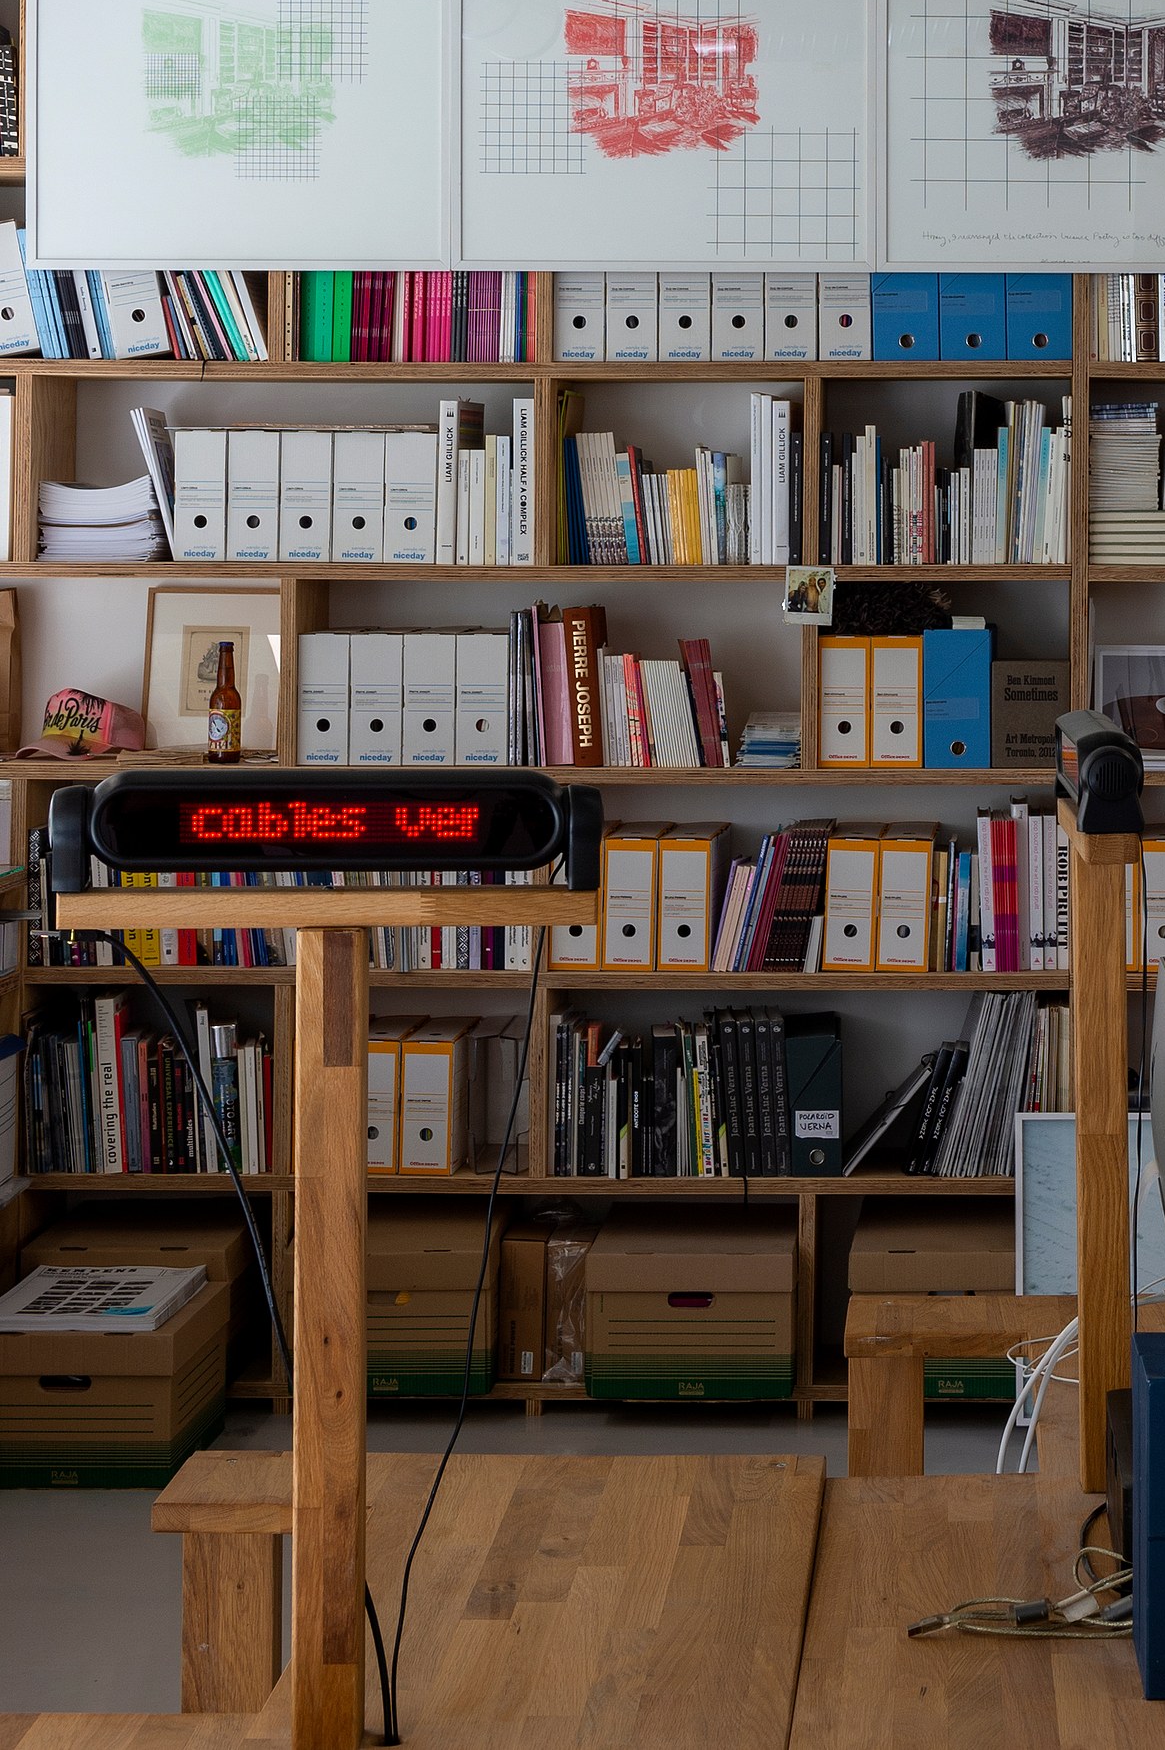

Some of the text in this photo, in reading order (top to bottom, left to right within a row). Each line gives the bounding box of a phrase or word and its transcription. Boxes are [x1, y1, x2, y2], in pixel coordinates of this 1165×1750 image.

[127, 341, 160, 354] niceday
[562, 350, 595, 359] niceday
[615, 350, 648, 359] niceday
[668, 350, 701, 359] niceday
[721, 350, 754, 359] niceday
[774, 350, 807, 358] niceday
[829, 349, 862, 358] niceday
[520, 408, 528, 429] LIAM
[520, 430, 528, 463] GILLICK
[445, 461, 453, 483] LIAM
[520, 464, 528, 485] HALF
[778, 463, 786, 483] LIAM
[520, 494, 528, 535] COMPLEX
[183, 550, 216, 559] niceday
[236, 550, 269, 559] niceday
[289, 550, 322, 559] niceday
[341, 550, 374, 559] niceday
[393, 551, 426, 560] niceday
[571, 620, 593, 748] PIERRE JOSEPH
[1007, 675, 1056, 685] Ben Kinmont
[1004, 687, 1059, 702] Sometimes
[60, 697, 103, 732] Paris
[1005, 733, 1019, 744] Art
[306, 753, 339, 762] niceday
[359, 753, 392, 762] niceday
[412, 753, 445, 762] niceday
[465, 753, 498, 762] niceday
[1006, 747, 1037, 759] Toronto,
[191, 801, 479, 839] cables ver
[1057, 845, 1068, 951] ROB PRUITT
[164, 1057, 174, 1148] UNIVERSAL EXPERIENCE
[727, 1065, 740, 1138] Jean-Luc Verna
[744, 1065, 756, 1138] Jean-Luc Verna
[760, 1065, 773, 1138] Jean-Luc Verna
[774, 1065, 787, 1138] Jean-Luc Verna
[100, 1061, 118, 1164] covering the real
[799, 1122, 832, 1131] VERNA
[372, 1377, 398, 1386] RAJA
[678, 1382, 704, 1391] RAJA
[938, 1380, 964, 1388] RAJA
[51, 1470, 79, 1479] RAJA
